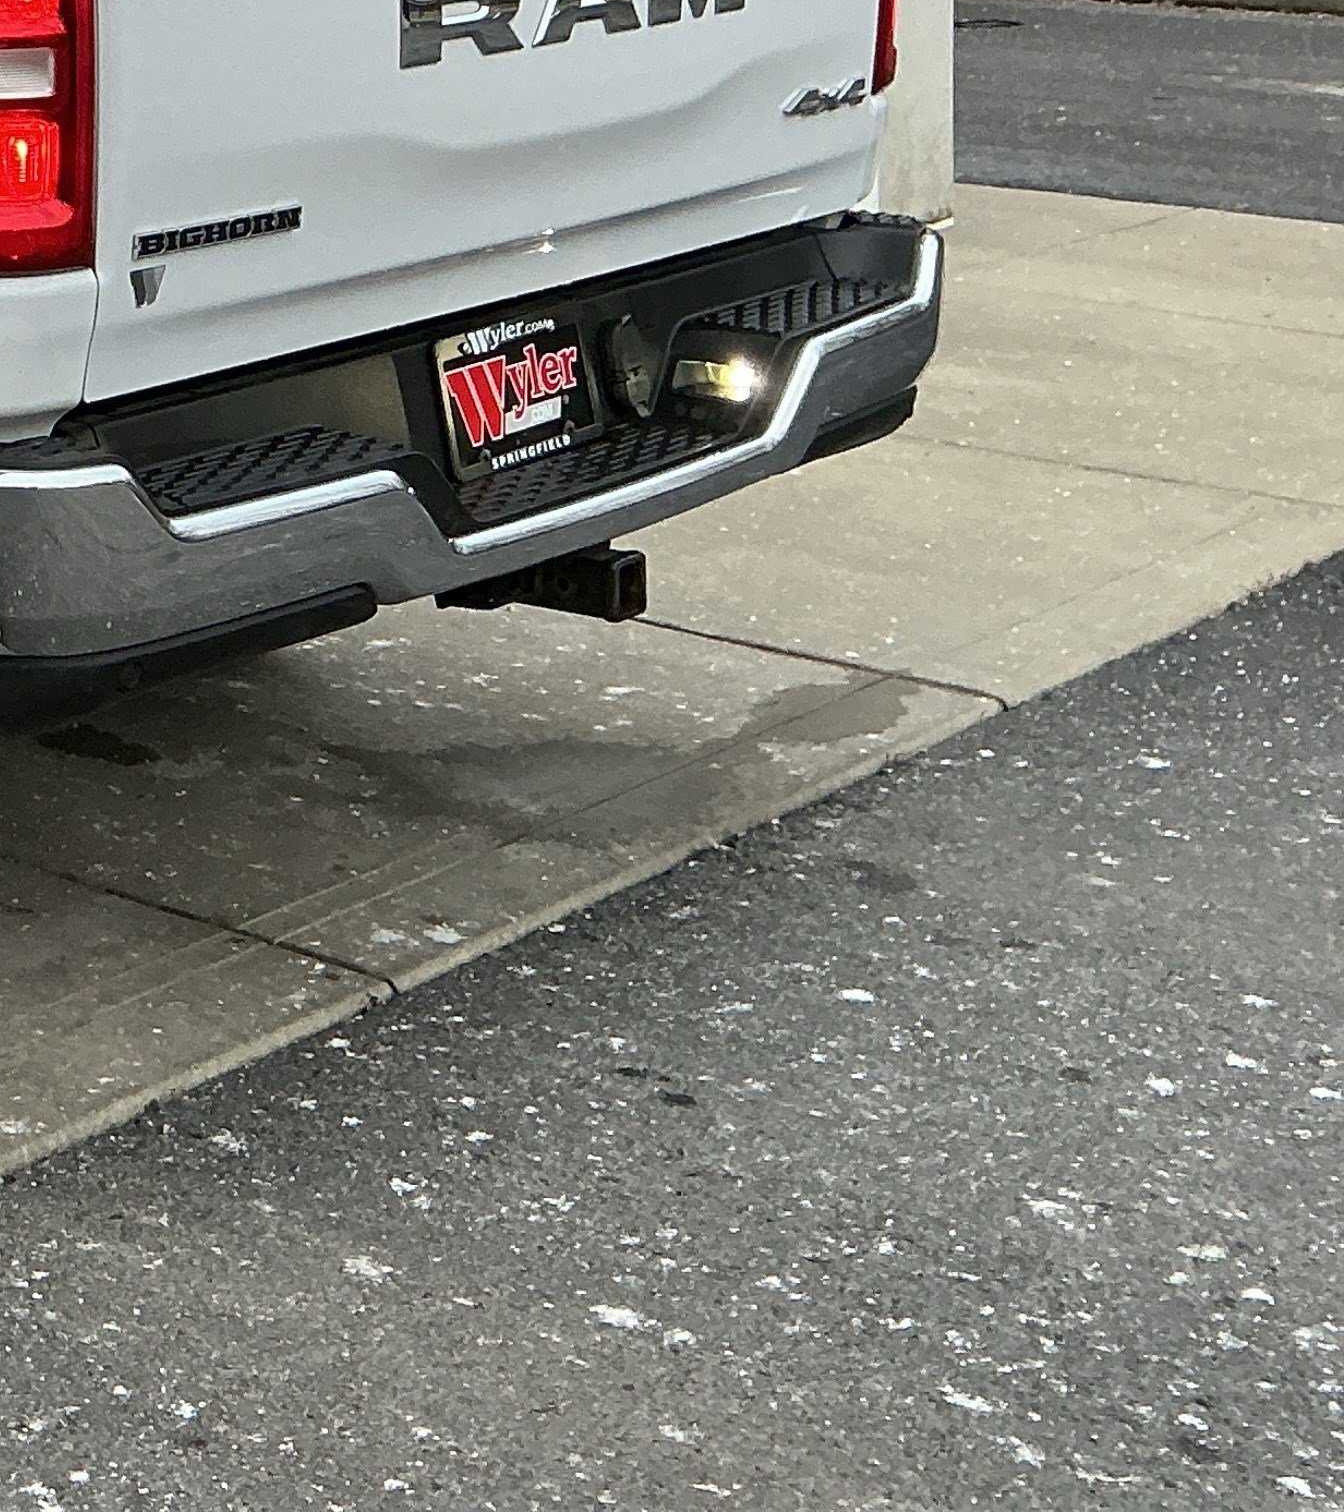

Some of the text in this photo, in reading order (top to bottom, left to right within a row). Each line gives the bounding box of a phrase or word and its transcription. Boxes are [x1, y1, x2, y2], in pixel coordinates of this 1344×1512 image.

[133, 204, 303, 260] BIGHORN
[443, 343, 578, 448] Wyler
[491, 433, 571, 471] SPRINGFIELD
